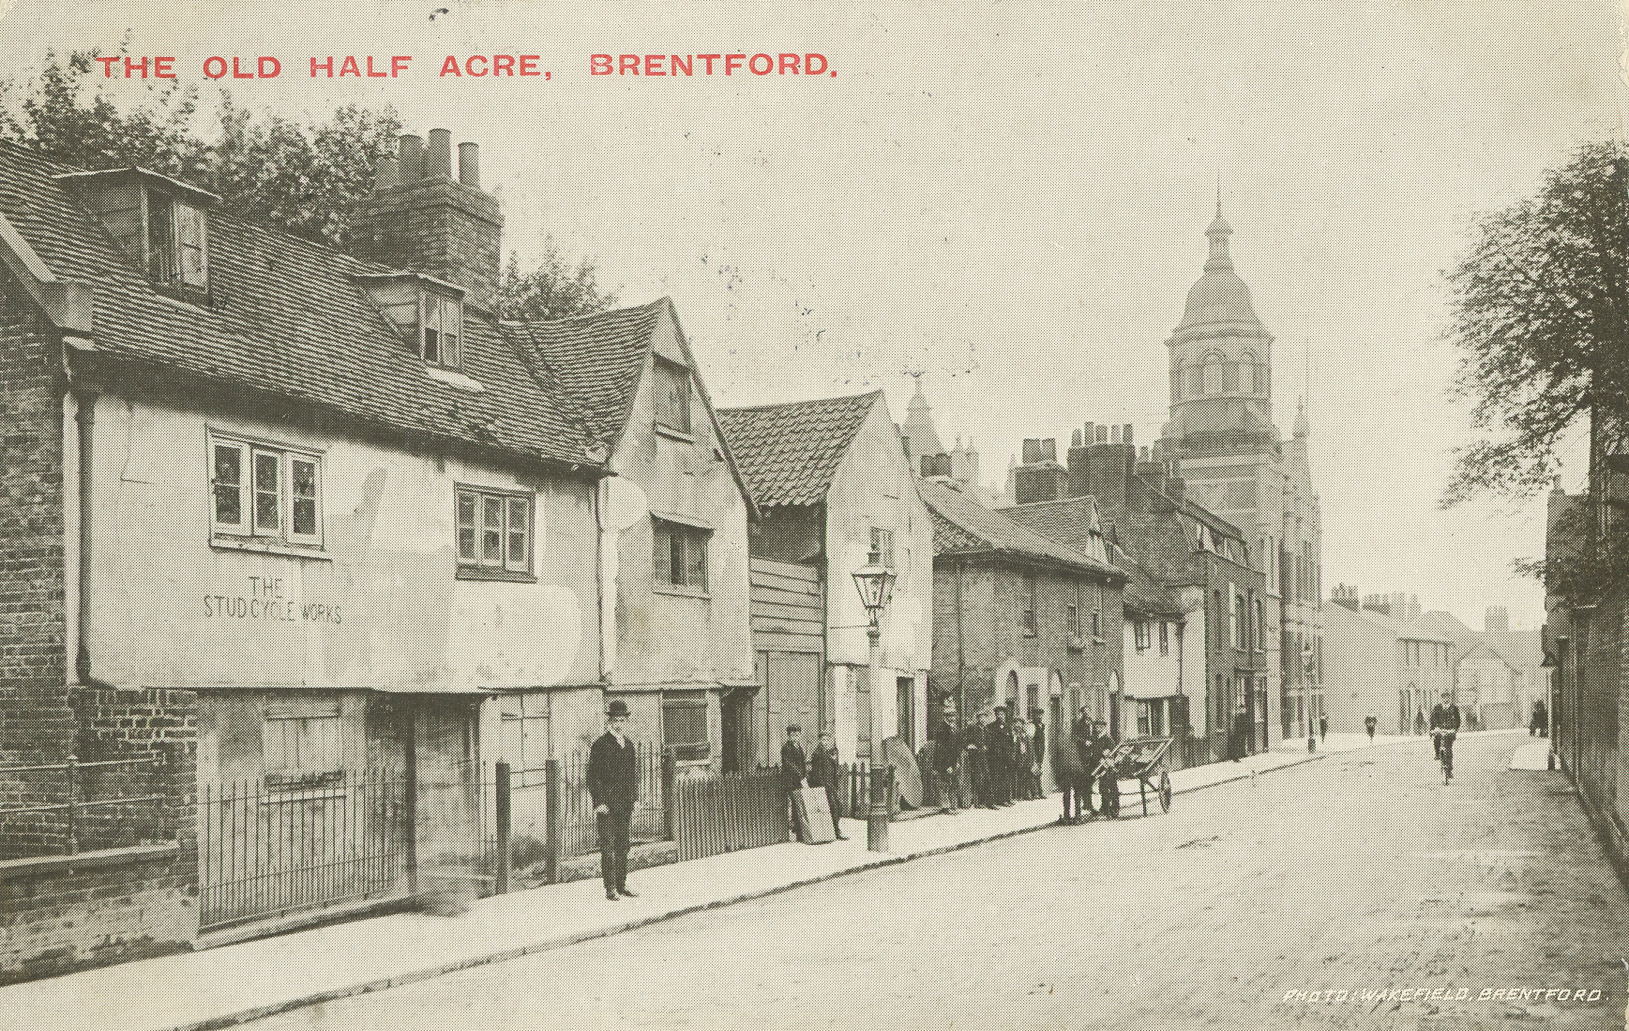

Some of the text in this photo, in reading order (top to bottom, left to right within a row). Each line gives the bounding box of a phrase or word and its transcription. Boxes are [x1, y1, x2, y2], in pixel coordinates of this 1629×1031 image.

[248, 576, 283, 598] THE
[203, 595, 342, 624] STUD CYCLE WORKS
